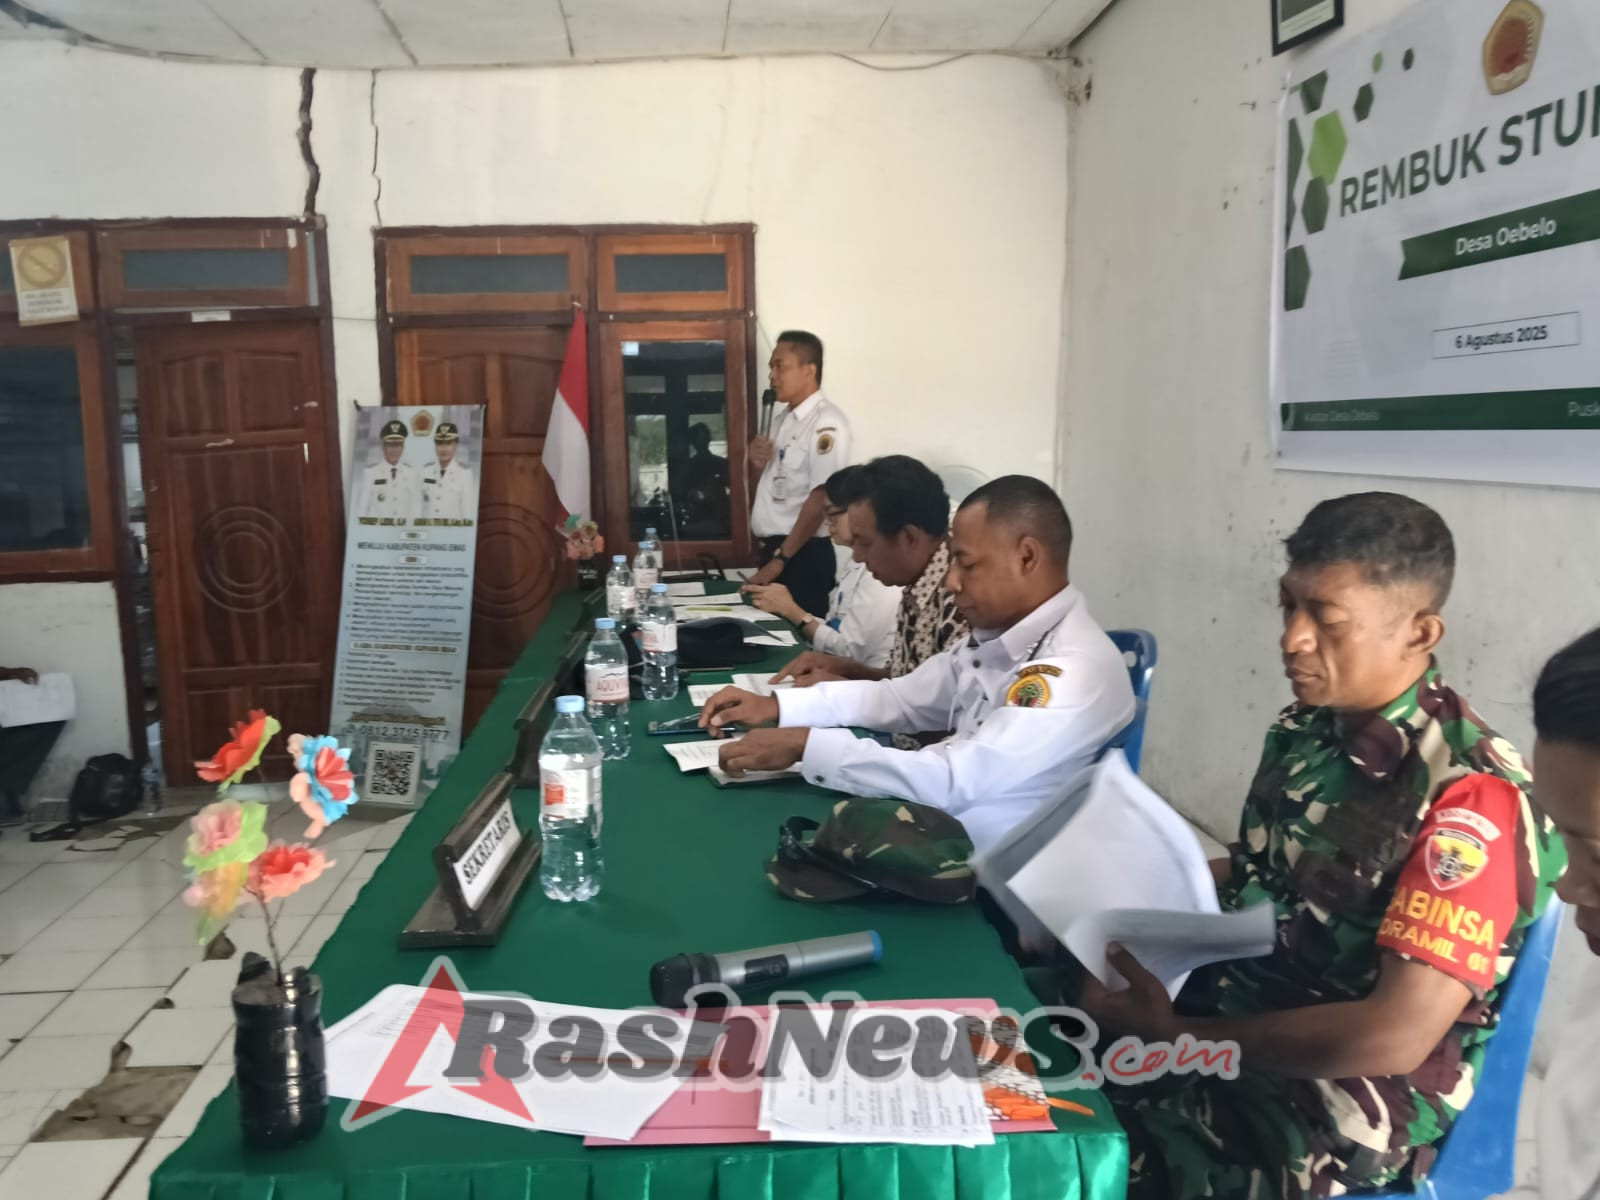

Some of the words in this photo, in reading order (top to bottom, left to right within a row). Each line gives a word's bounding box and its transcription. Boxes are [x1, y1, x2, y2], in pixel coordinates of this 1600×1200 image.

[1340, 126, 1488, 218] REMBUK
[1455, 234, 1493, 256] Desa
[1496, 216, 1557, 246] Oebelo
[1455, 335, 1463, 349] 6
[1465, 331, 1514, 351] Agustus
[1517, 325, 1549, 343] 2025
[461, 810, 513, 885] SEKRETARIS
[1379, 918, 1460, 963] ORAMIL
[1386, 886, 1495, 952] ABINSA
